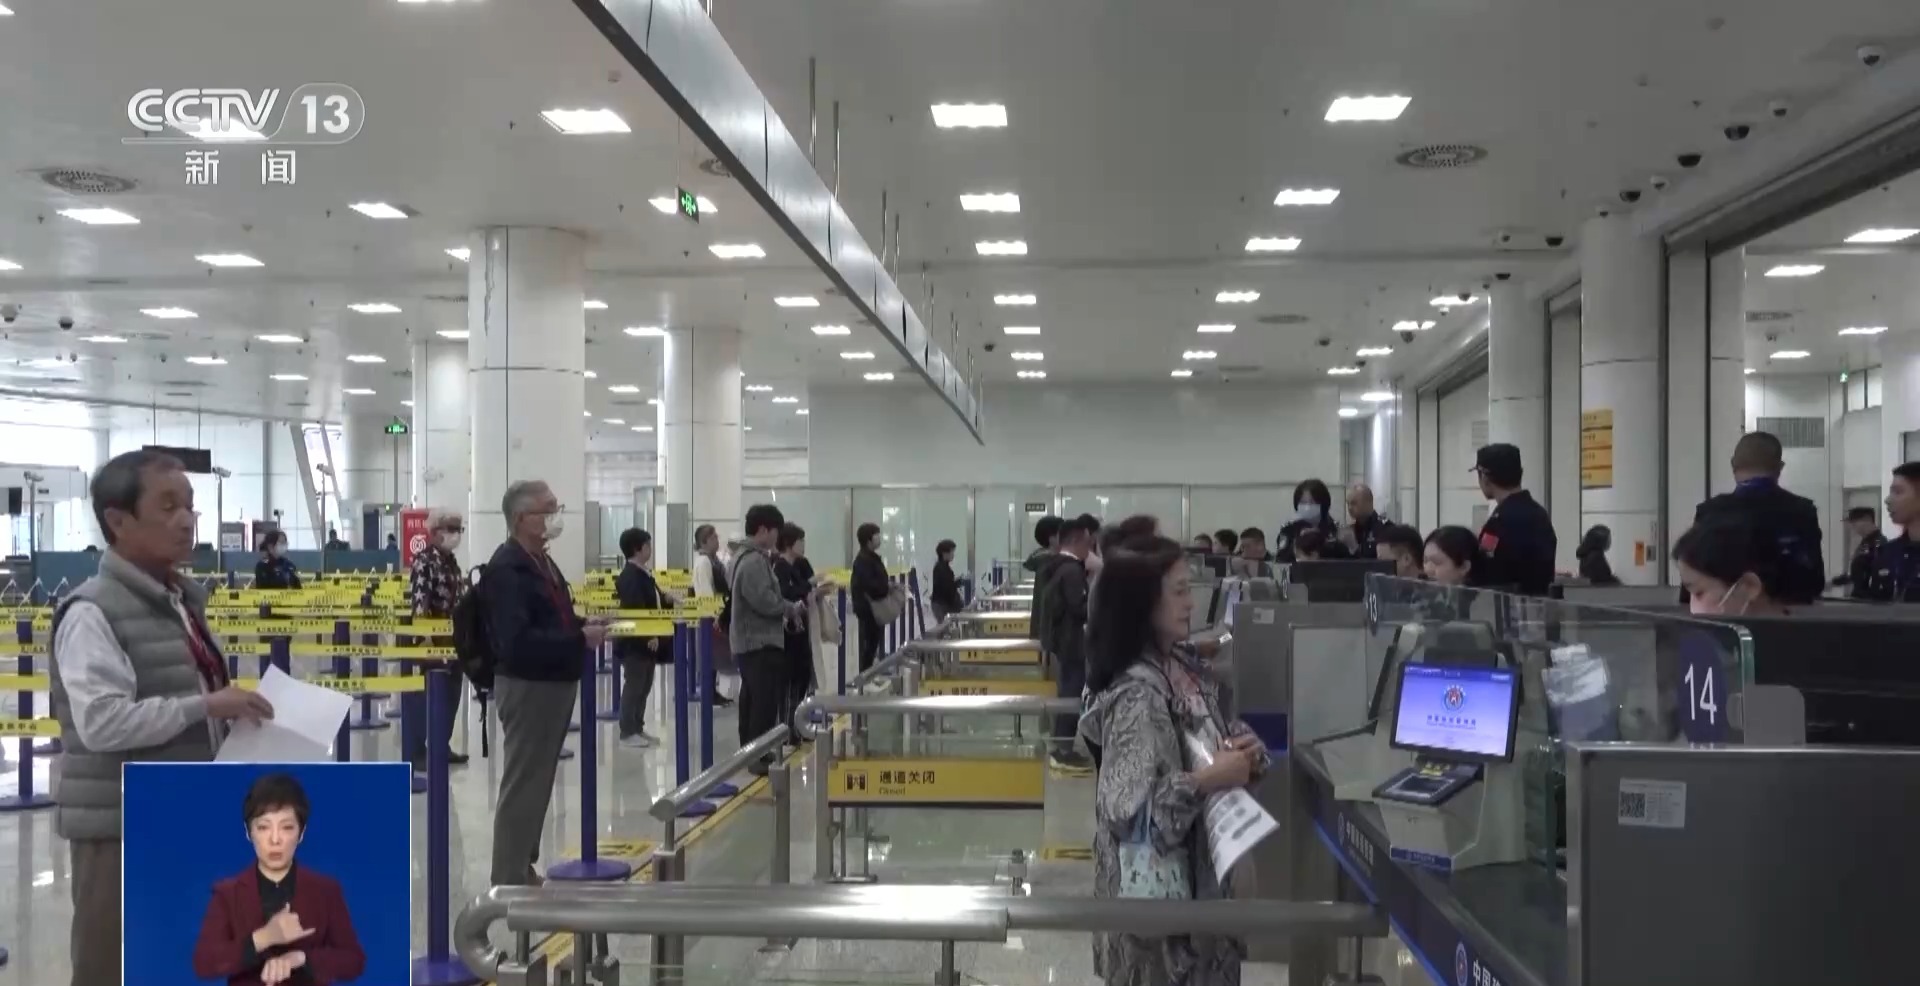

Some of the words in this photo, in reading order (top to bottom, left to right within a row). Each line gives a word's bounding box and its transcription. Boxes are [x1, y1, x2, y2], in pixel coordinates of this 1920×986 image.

[1369, 592, 1378, 622] 13
[1684, 663, 1717, 725] 14
[879, 770, 935, 785] 通道关闭
